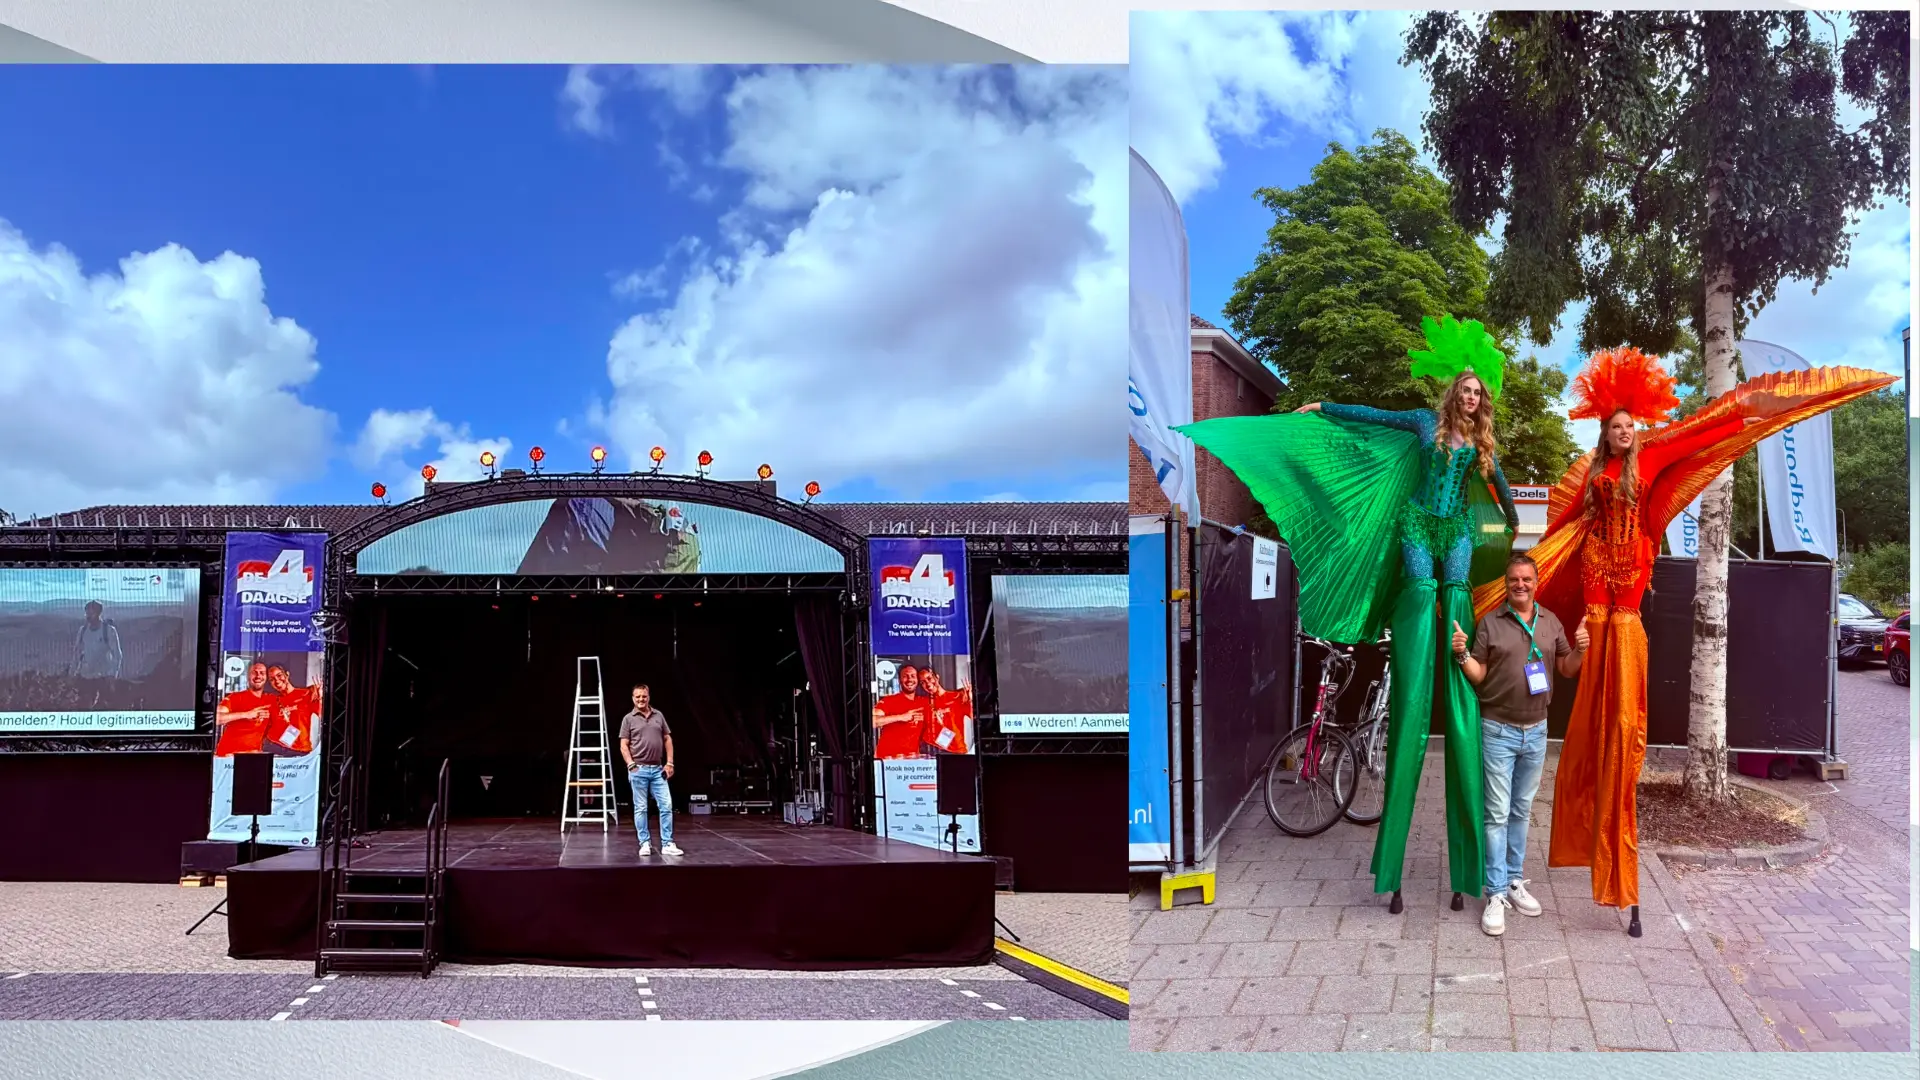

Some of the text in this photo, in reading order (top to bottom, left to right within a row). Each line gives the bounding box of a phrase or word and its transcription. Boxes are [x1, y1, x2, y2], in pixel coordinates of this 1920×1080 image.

[1511, 488, 1546, 498] Boels
[241, 592, 307, 604] DAAGSE
[886, 596, 950, 608] DAAGSE
[0, 714, 195, 728] melden? Houd legitimatiebewijs
[1028, 716, 1077, 728] Wedren!
